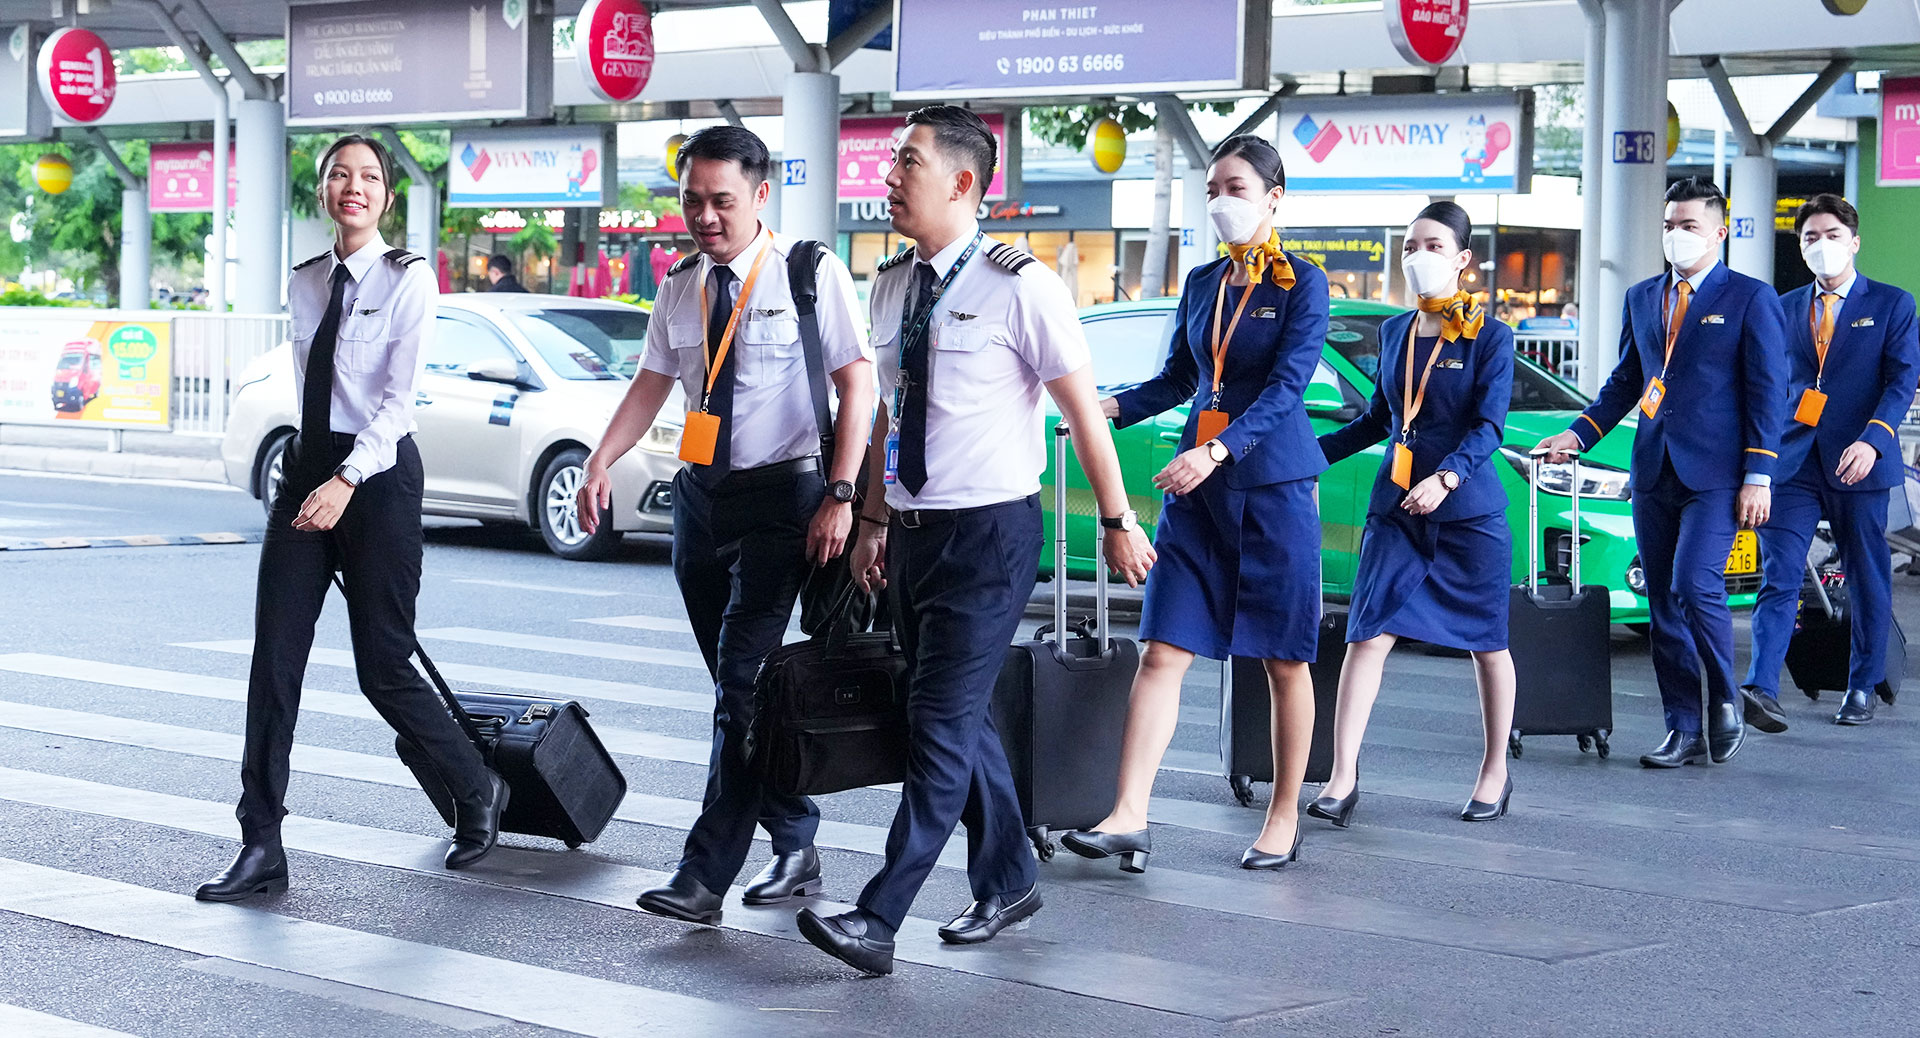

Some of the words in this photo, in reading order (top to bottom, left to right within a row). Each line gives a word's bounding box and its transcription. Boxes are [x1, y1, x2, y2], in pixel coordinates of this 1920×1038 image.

[1022, 9, 1057, 21] PHAN
[1015, 56, 1055, 75] 1900
[1058, 55, 1079, 73] 63
[1082, 53, 1124, 72] 6666
[1374, 124, 1449, 145] VNPAY
[1615, 133, 1654, 162] B-13
[512, 151, 560, 168] VNPAY
[1724, 553, 1751, 571] 2.16
